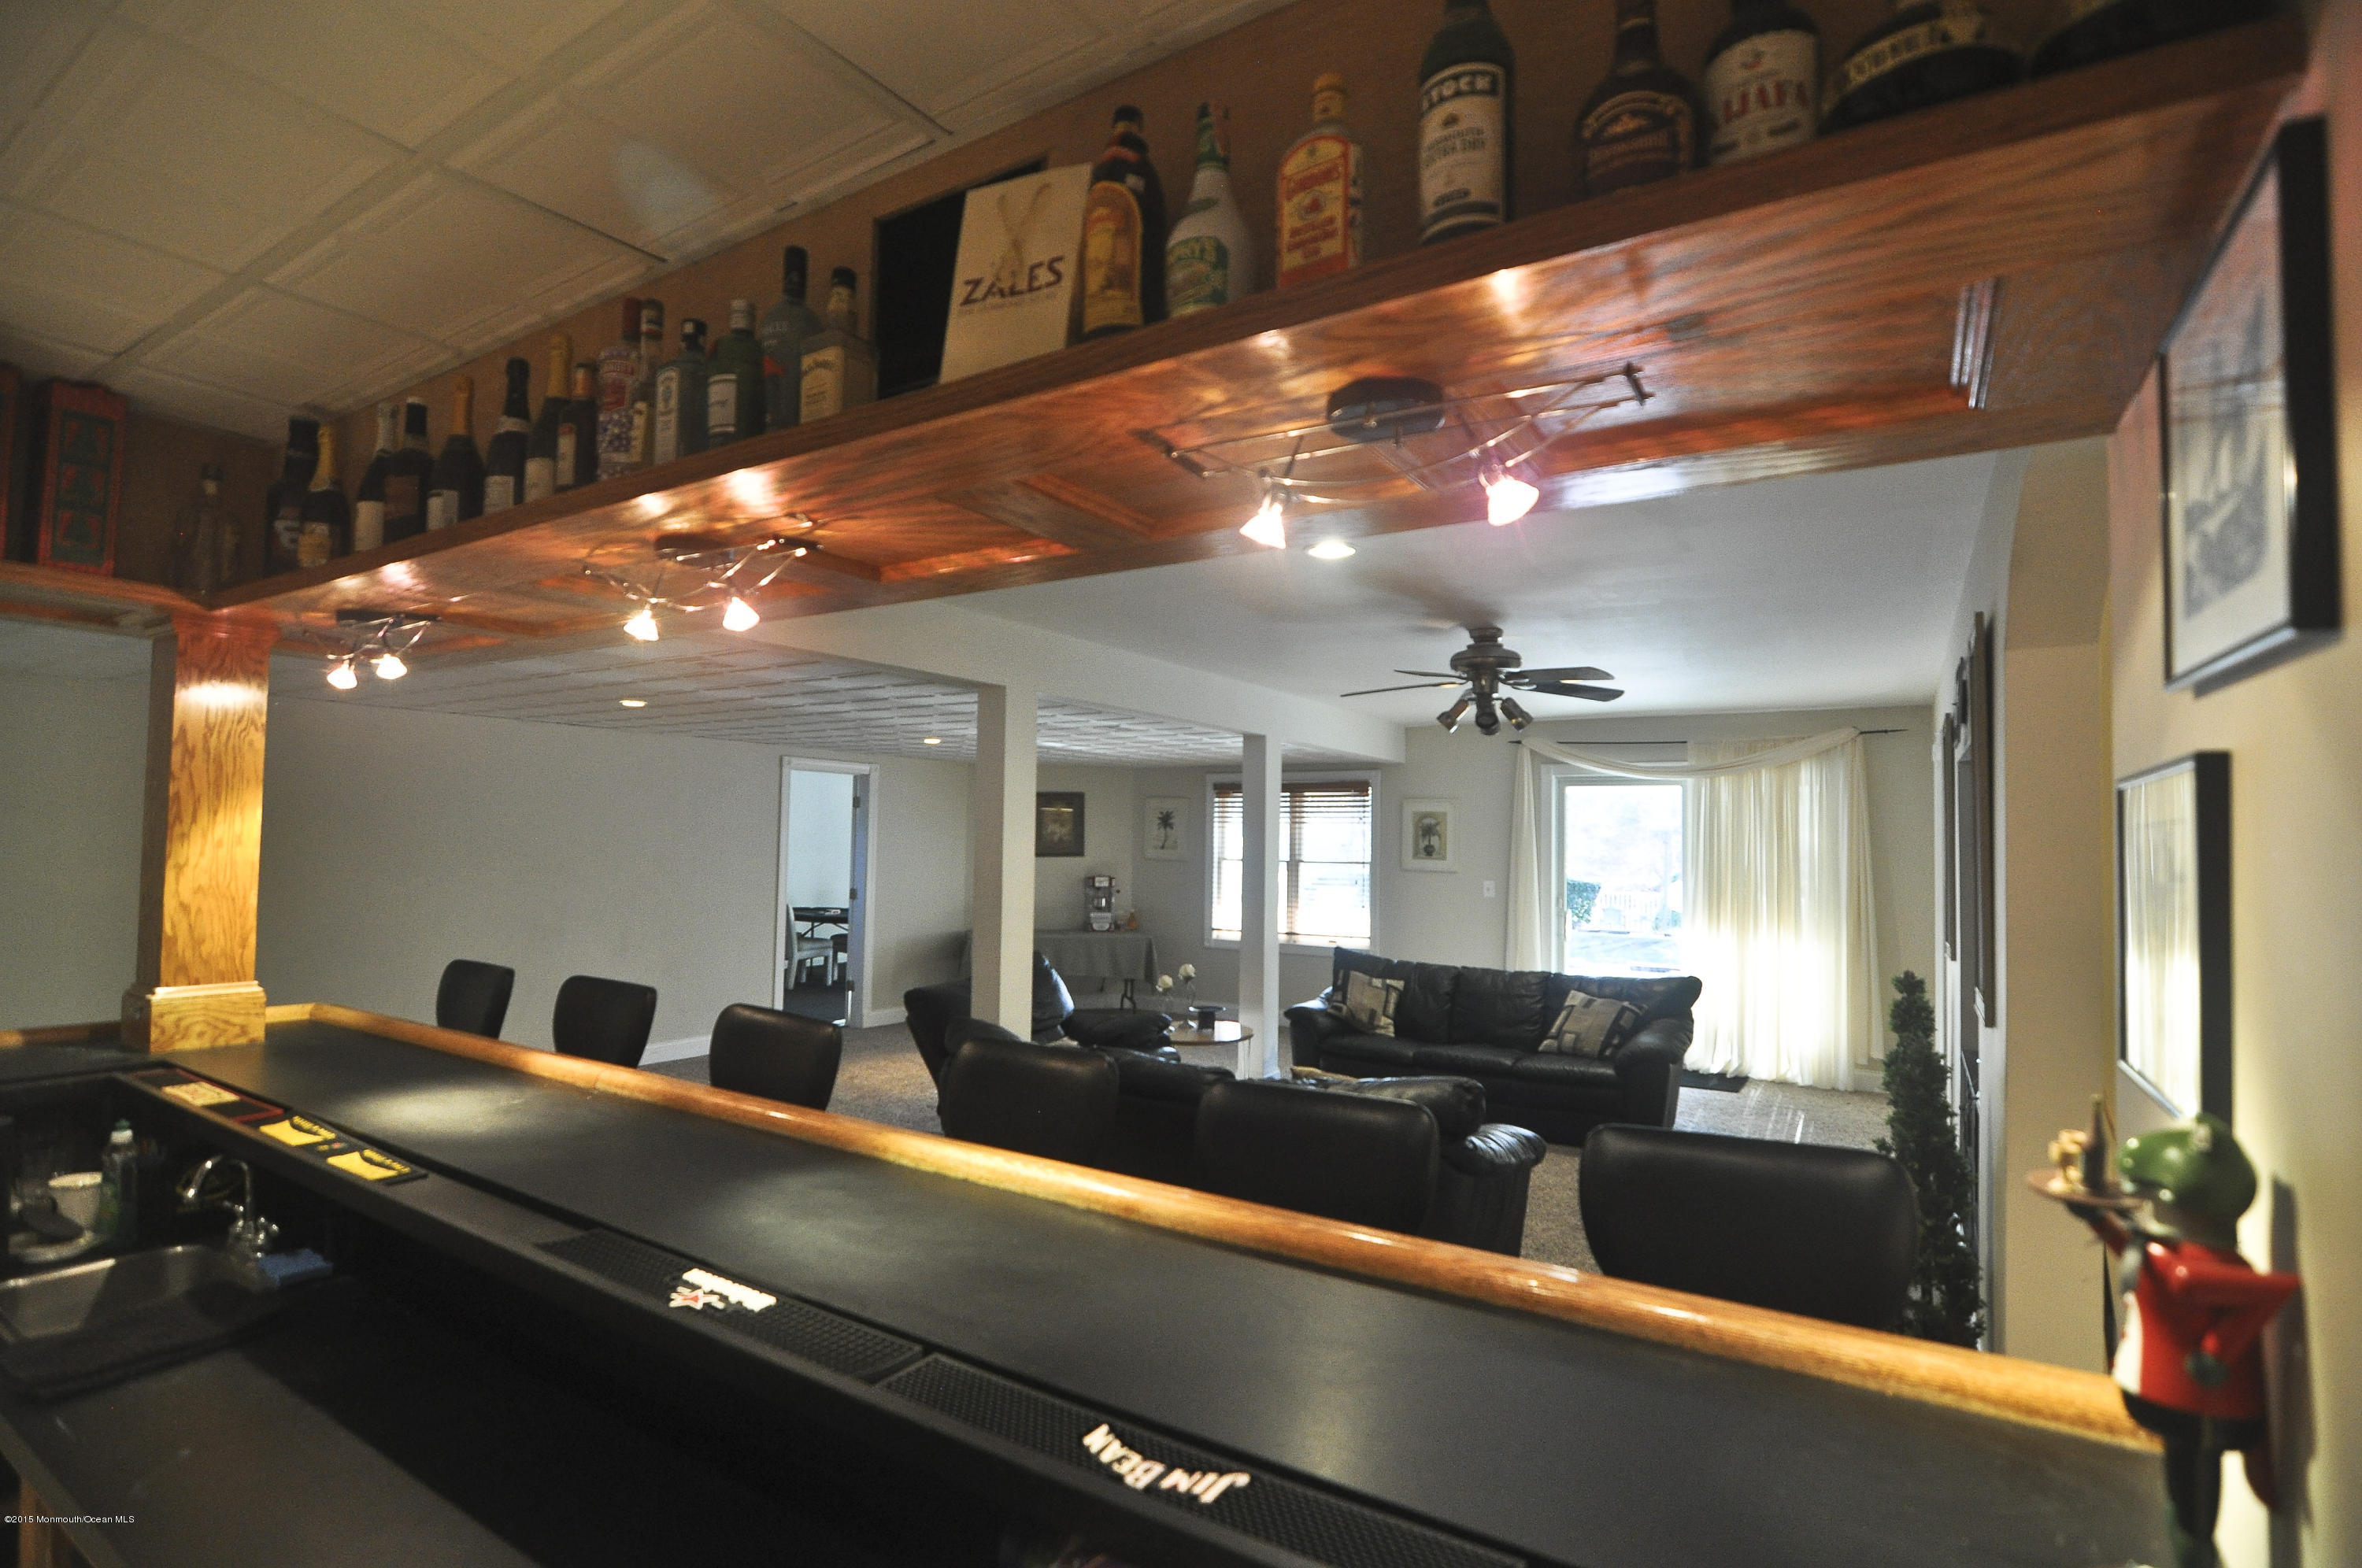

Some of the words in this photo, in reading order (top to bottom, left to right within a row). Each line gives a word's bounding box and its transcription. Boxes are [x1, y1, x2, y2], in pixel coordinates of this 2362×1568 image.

[1422, 75, 1493, 111] STOCK
[959, 253, 1065, 307] ZALES
[1159, 1467, 1251, 1504] JIM
